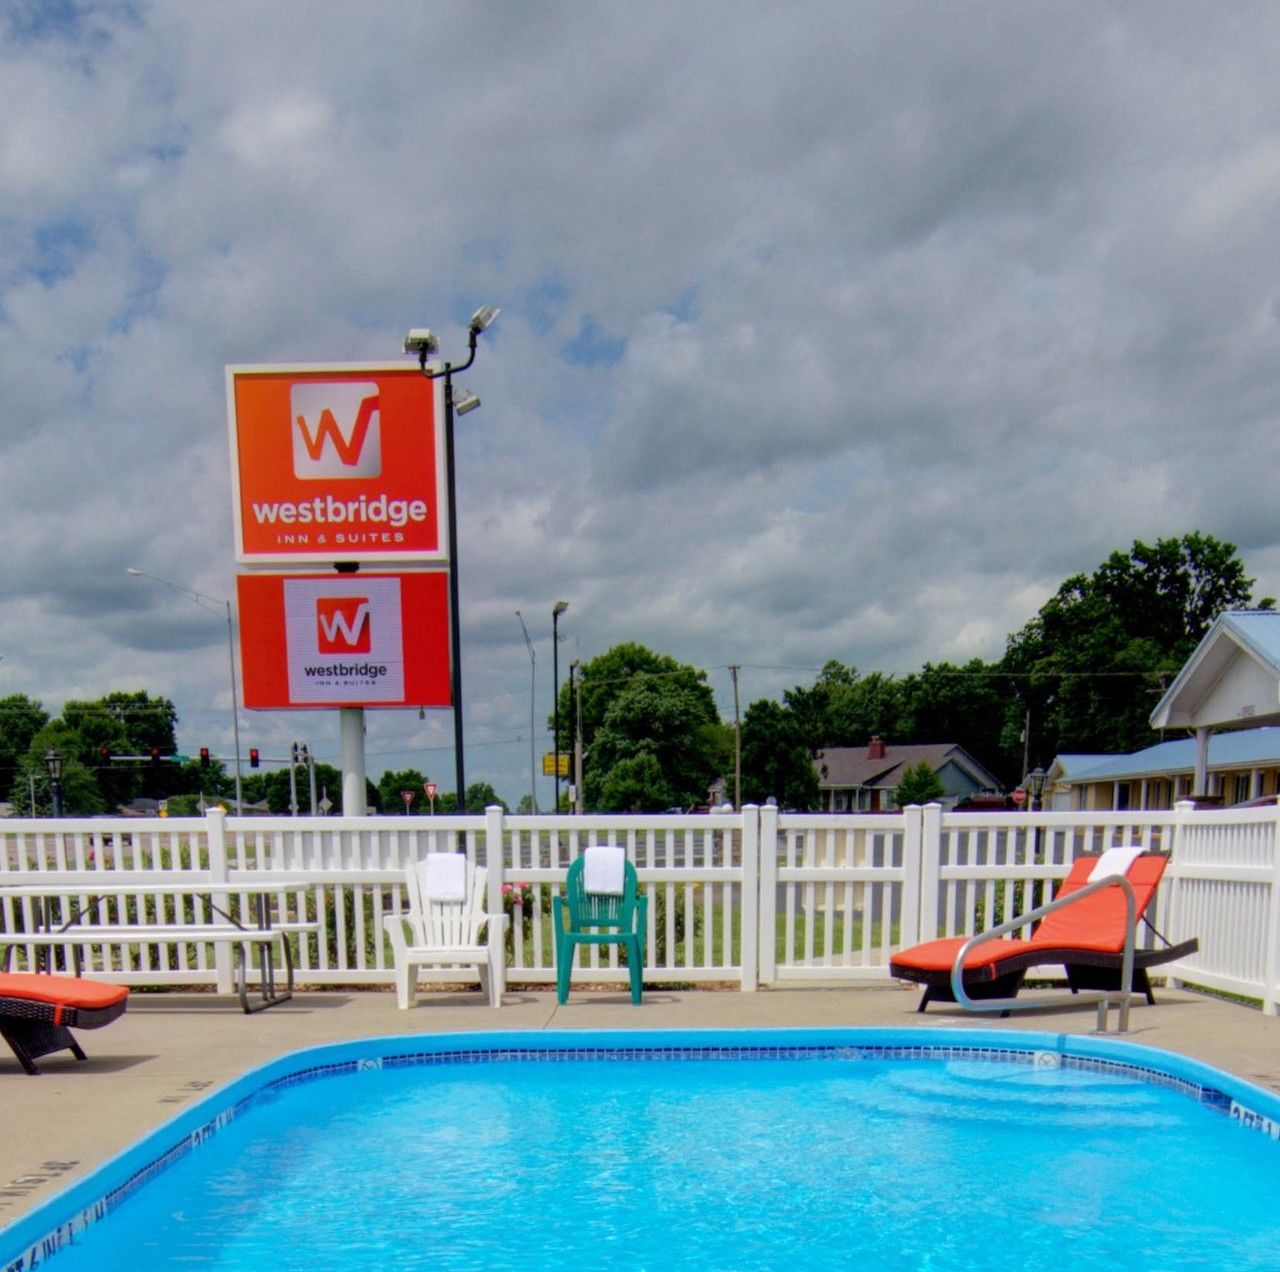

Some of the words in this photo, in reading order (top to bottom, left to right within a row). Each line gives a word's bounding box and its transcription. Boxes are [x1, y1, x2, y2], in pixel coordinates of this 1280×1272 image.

[252, 494, 427, 527] westbridge
[277, 534, 309, 544] INN
[317, 534, 326, 543] &
[335, 532, 404, 543] SUITES
[305, 662, 387, 679] westbridge
